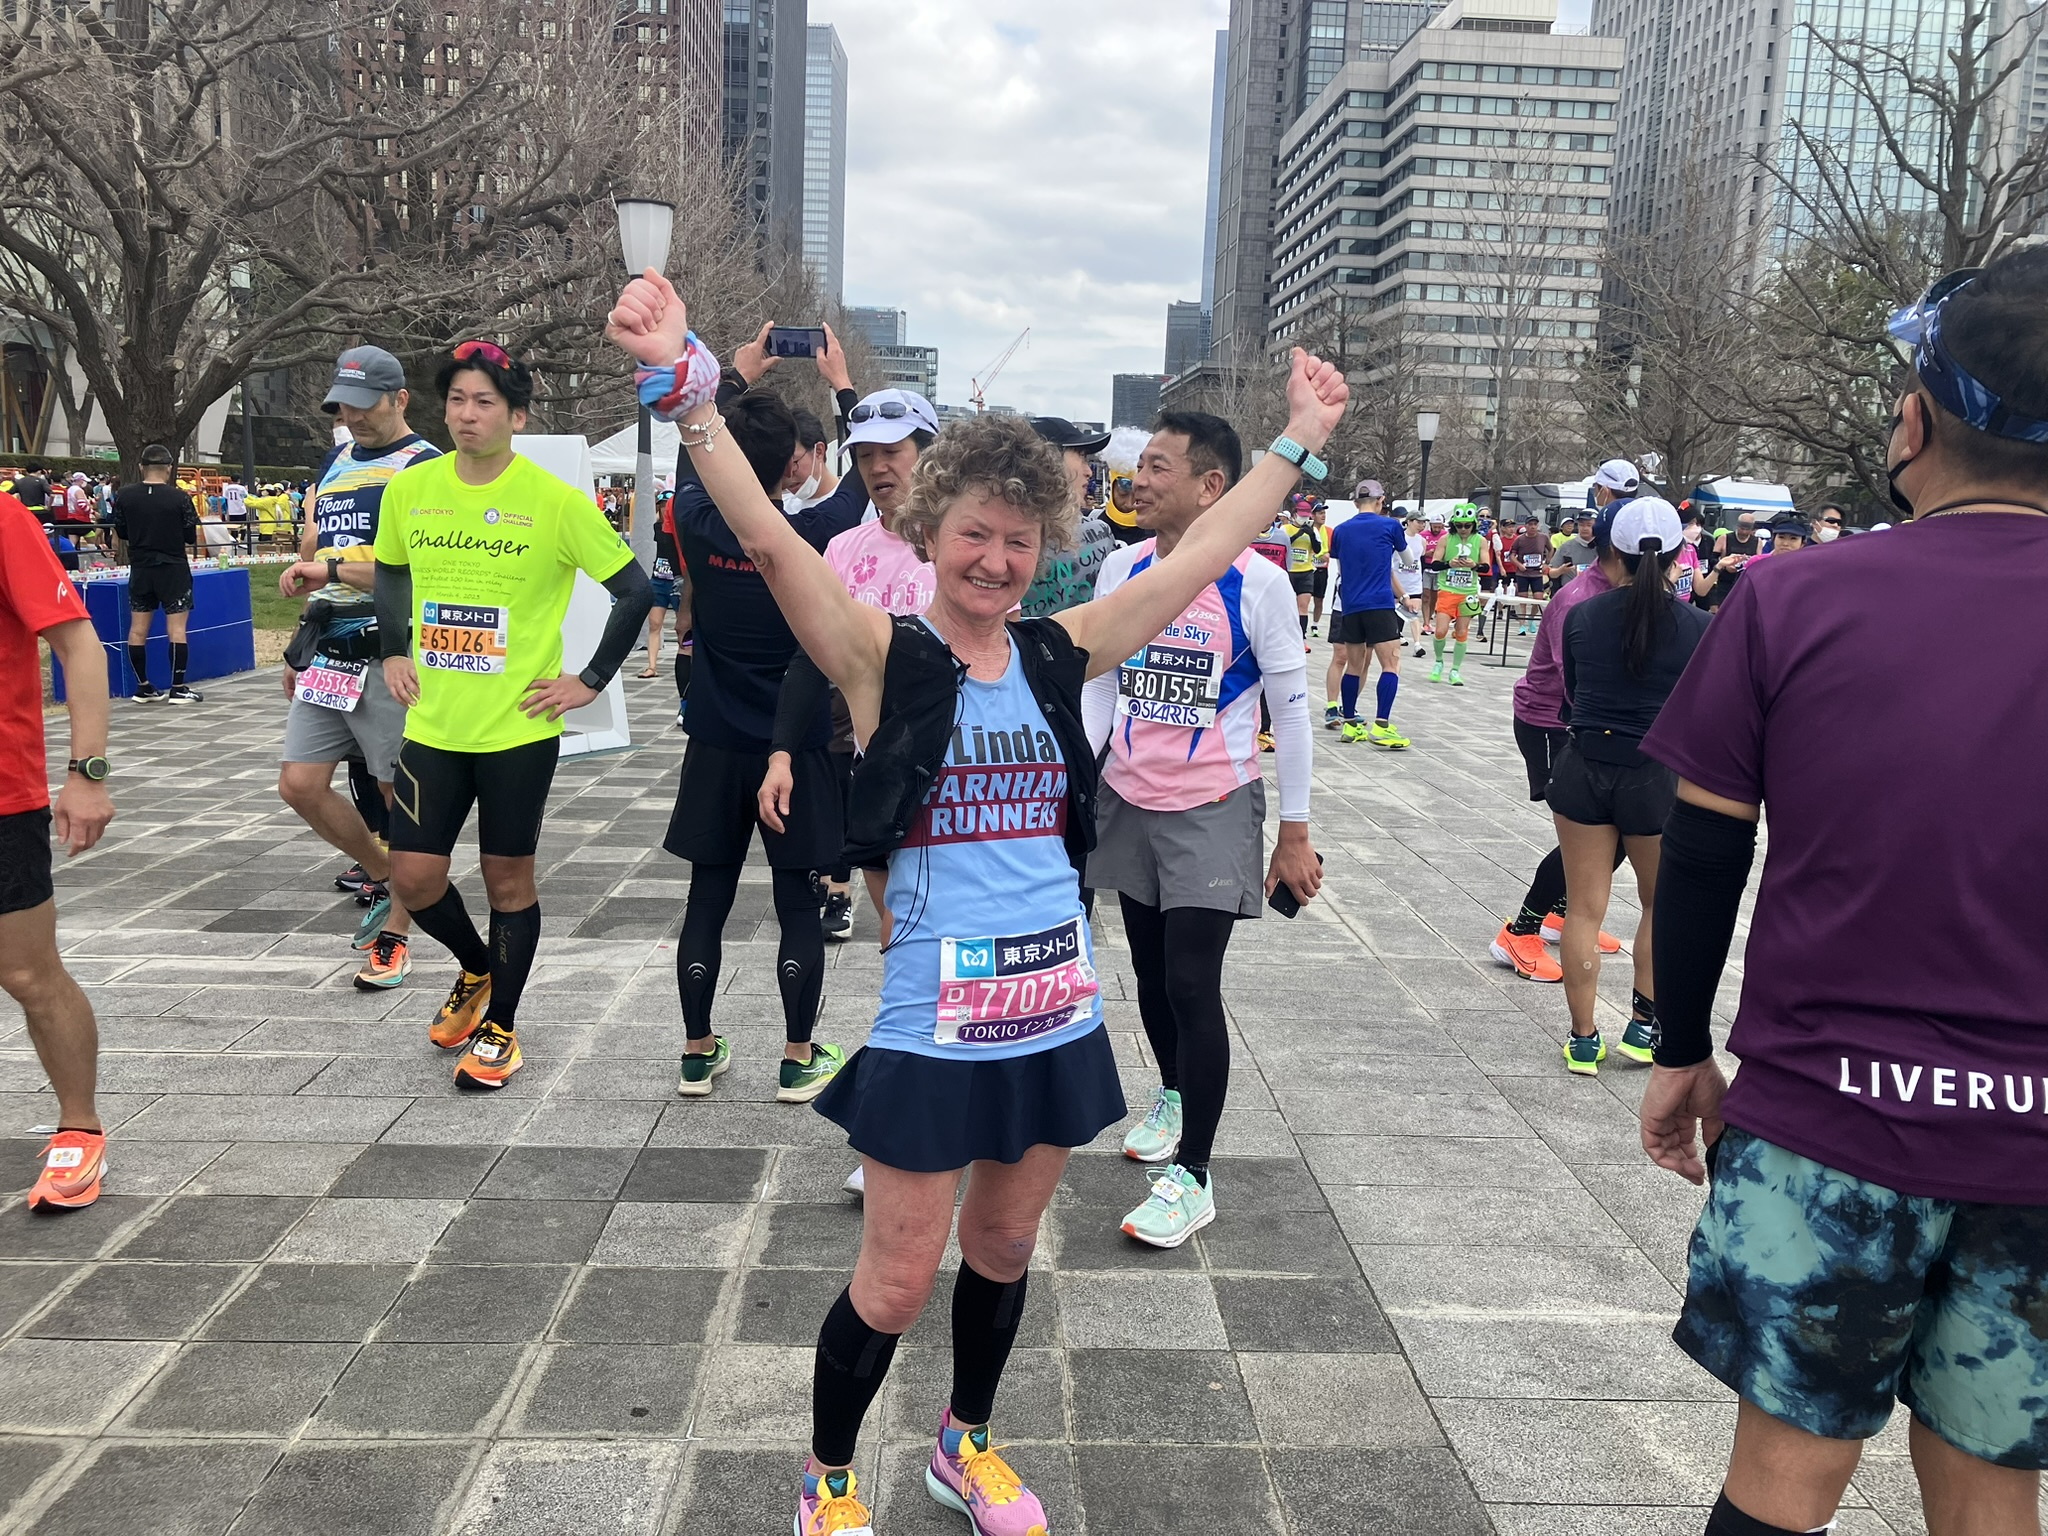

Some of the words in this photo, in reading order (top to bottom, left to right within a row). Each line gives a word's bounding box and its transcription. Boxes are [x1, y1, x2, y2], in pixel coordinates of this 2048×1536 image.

[318, 497, 355, 515] Team
[503, 512, 534, 522] OFFICIAL
[317, 512, 371, 535] ADDIE
[502, 519, 533, 528] CHALLENGE
[409, 529, 530, 557] Challenger
[708, 554, 760, 573] MAM
[882, 584, 900, 608] de
[440, 609, 495, 623] 東京メトロ
[1198, 610, 1220, 621] asics
[431, 628, 484, 653] 65126
[1164, 623, 1180, 637] de
[1184, 625, 1210, 645] Sky
[326, 658, 362, 672] 東京メトロ
[1149, 651, 1209, 670] 東京メトロ
[312, 670, 350, 694] 75536
[1121, 672, 1129, 686] B
[1134, 671, 1196, 704] 80155
[952, 724, 1057, 765] Linda
[922, 771, 1068, 805] FARNHAM
[931, 801, 1060, 837] RUNNERS
[1003, 932, 1075, 966] 東京メトロ
[946, 987, 965, 1003] D
[979, 969, 1071, 1018] 77075
[961, 1023, 1018, 1039] TOKIO
